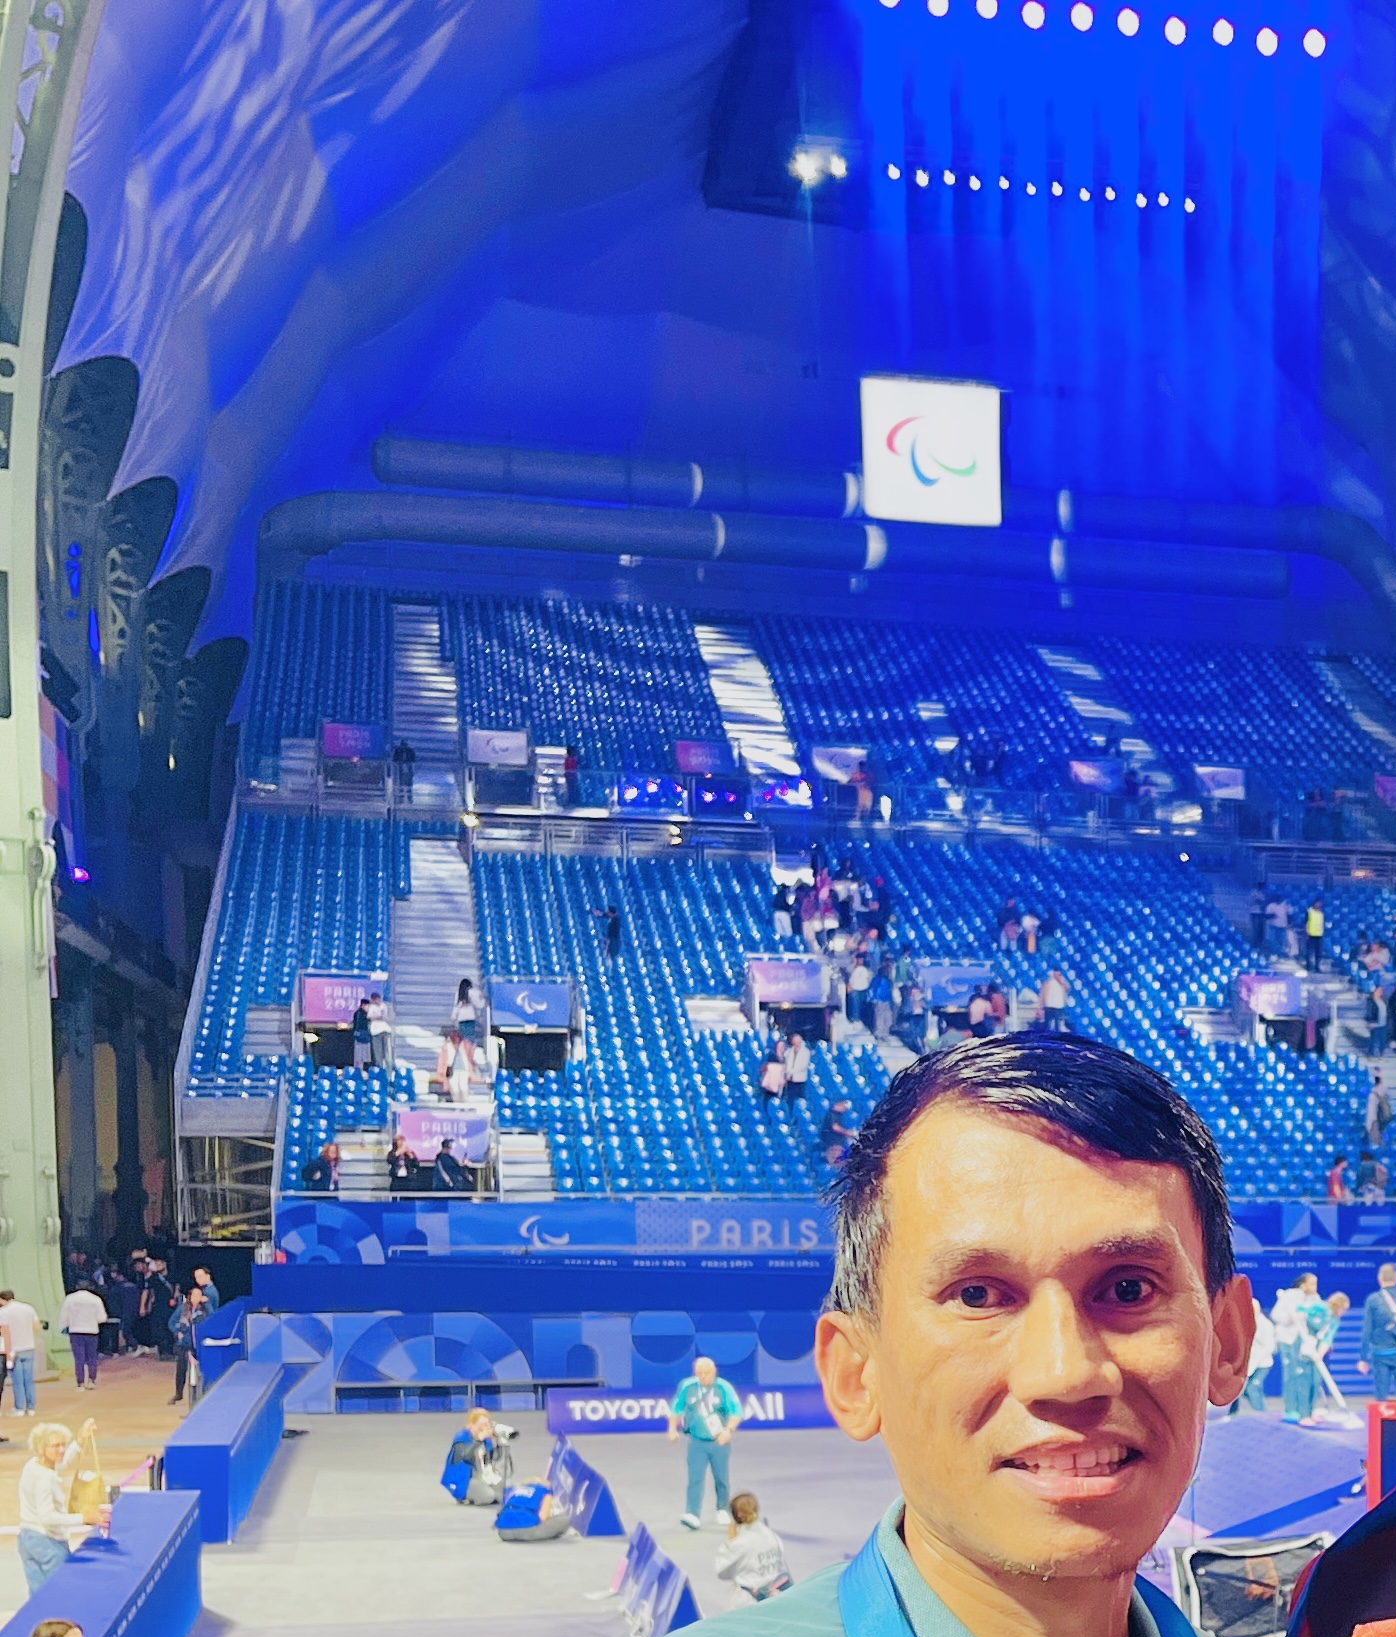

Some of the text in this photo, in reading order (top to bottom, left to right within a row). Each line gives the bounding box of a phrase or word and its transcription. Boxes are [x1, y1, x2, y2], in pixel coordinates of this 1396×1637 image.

[421, 1121, 467, 1134] PARIS
[690, 1218, 819, 1248] PARIS
[568, 1398, 671, 1421] TOYOTA
